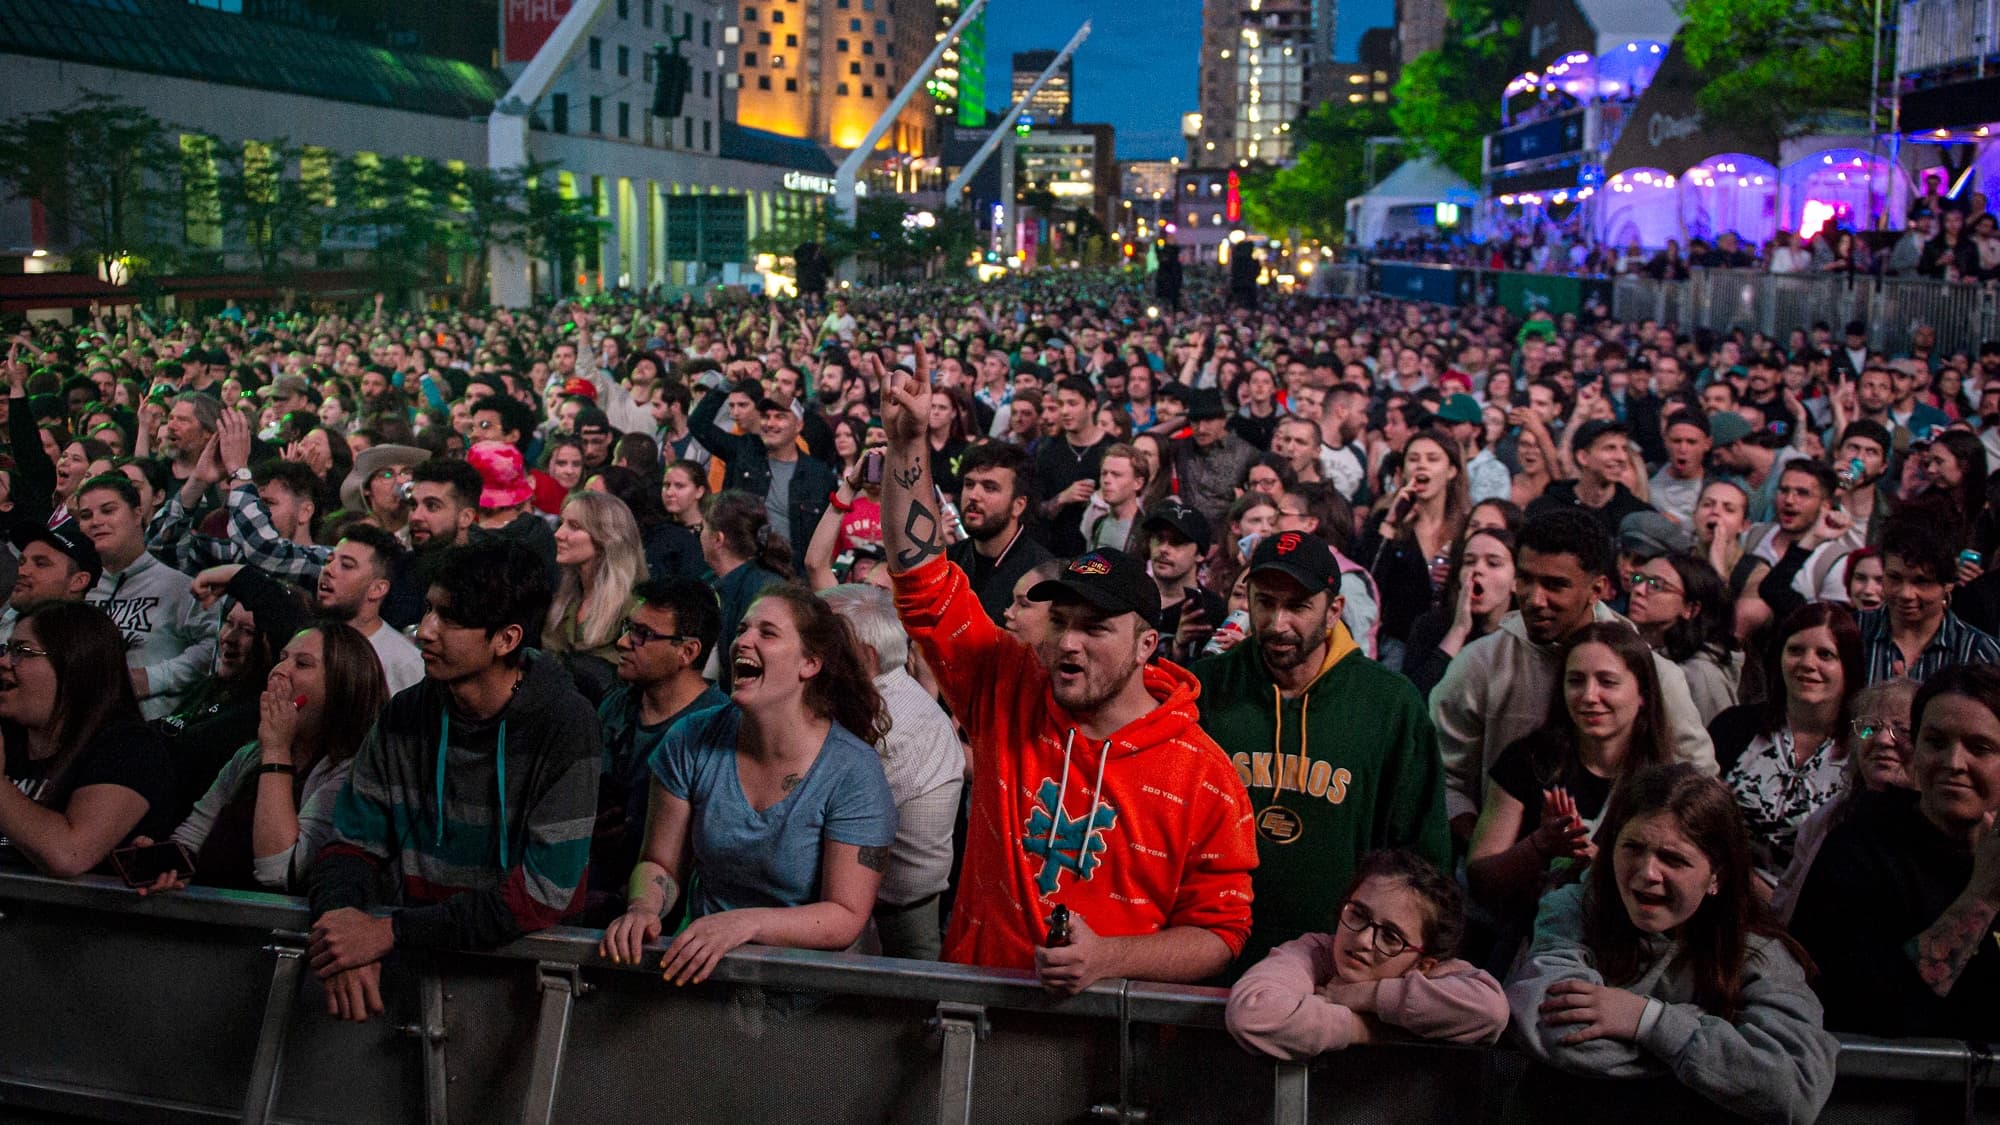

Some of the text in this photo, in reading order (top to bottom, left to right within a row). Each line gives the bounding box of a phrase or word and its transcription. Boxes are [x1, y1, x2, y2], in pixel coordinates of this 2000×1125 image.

[1233, 751, 1352, 805] SKIMOS
[1141, 783, 1185, 805] ZOO YORK
[1261, 812, 1296, 838] EE
